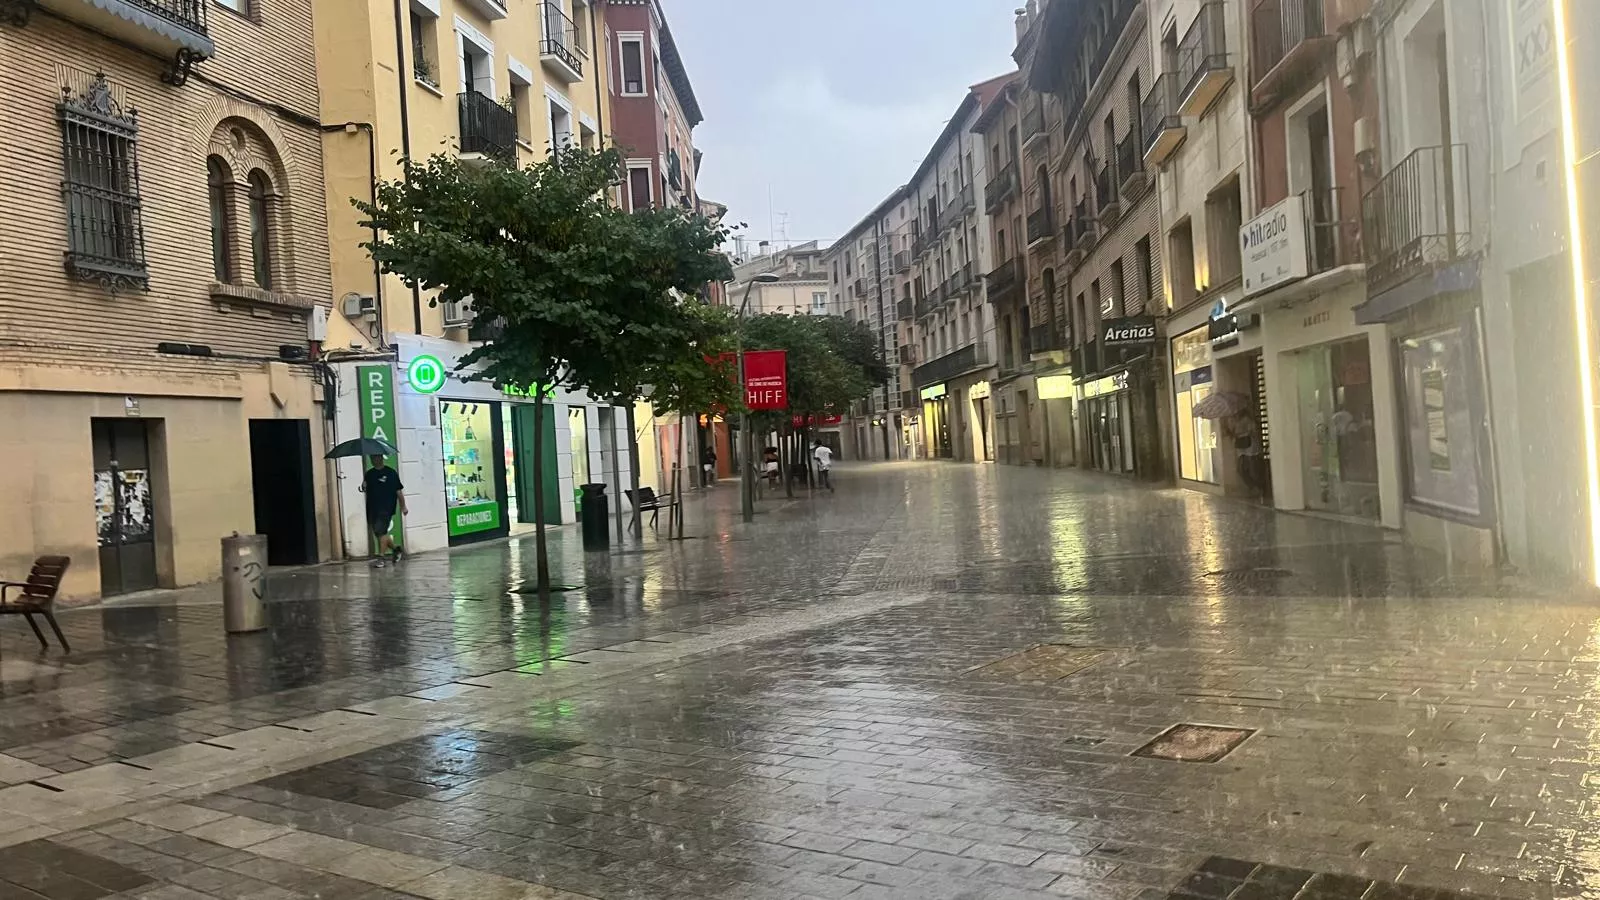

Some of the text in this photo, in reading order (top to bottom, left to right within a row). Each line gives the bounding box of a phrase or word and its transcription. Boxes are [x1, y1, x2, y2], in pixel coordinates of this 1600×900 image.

[1250, 210, 1287, 248] hitradio
[1104, 327, 1155, 341] Arenas
[748, 390, 783, 404] HIFF
